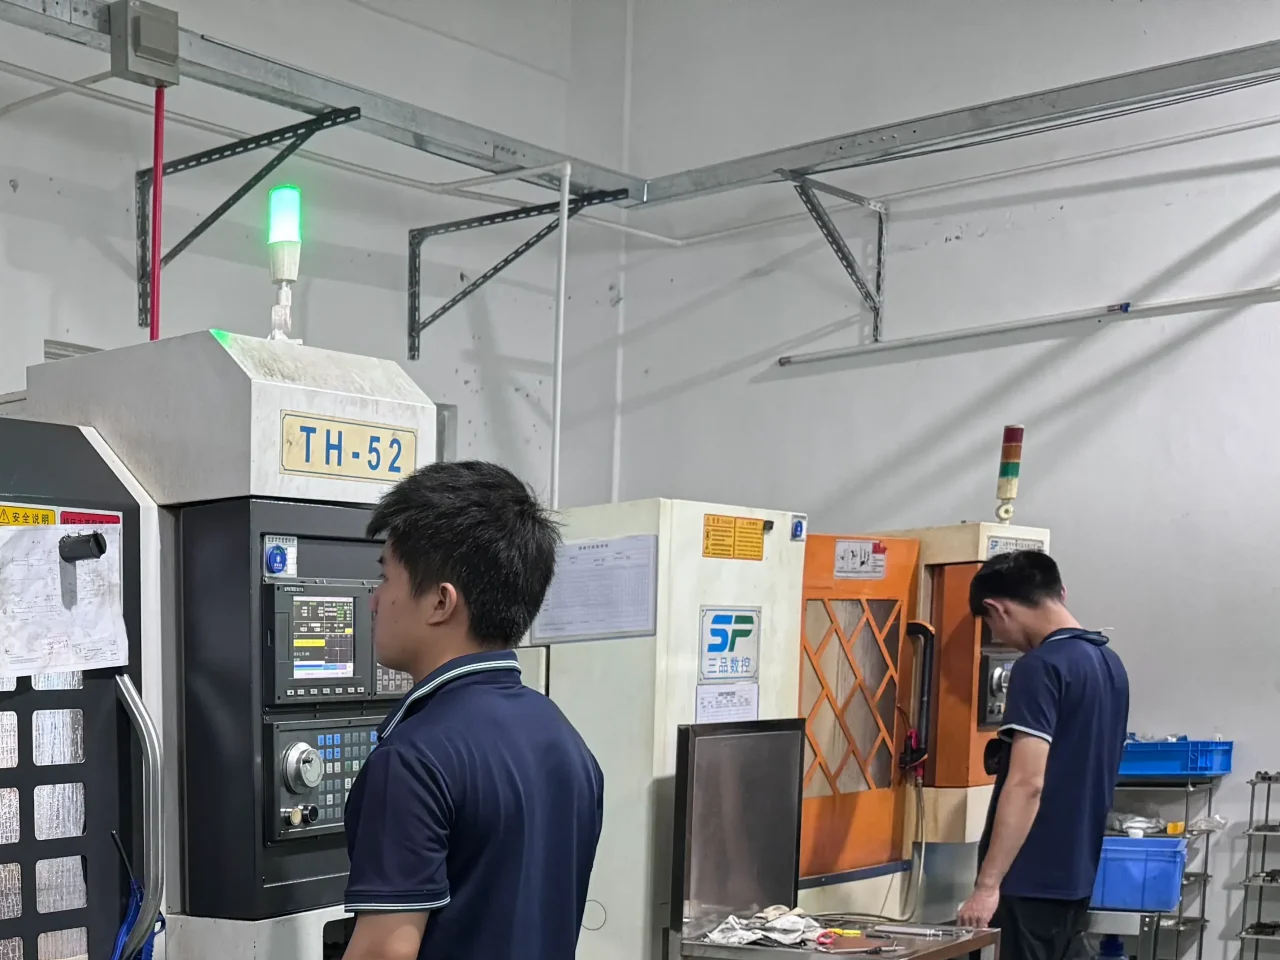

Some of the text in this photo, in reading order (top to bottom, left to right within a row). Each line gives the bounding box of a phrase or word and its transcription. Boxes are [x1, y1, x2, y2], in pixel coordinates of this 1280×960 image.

[298, 425, 403, 474] TH-52
[11, 511, 50, 525] 安全说明
[706, 614, 755, 653] SP
[707, 656, 752, 674] 三品数控
